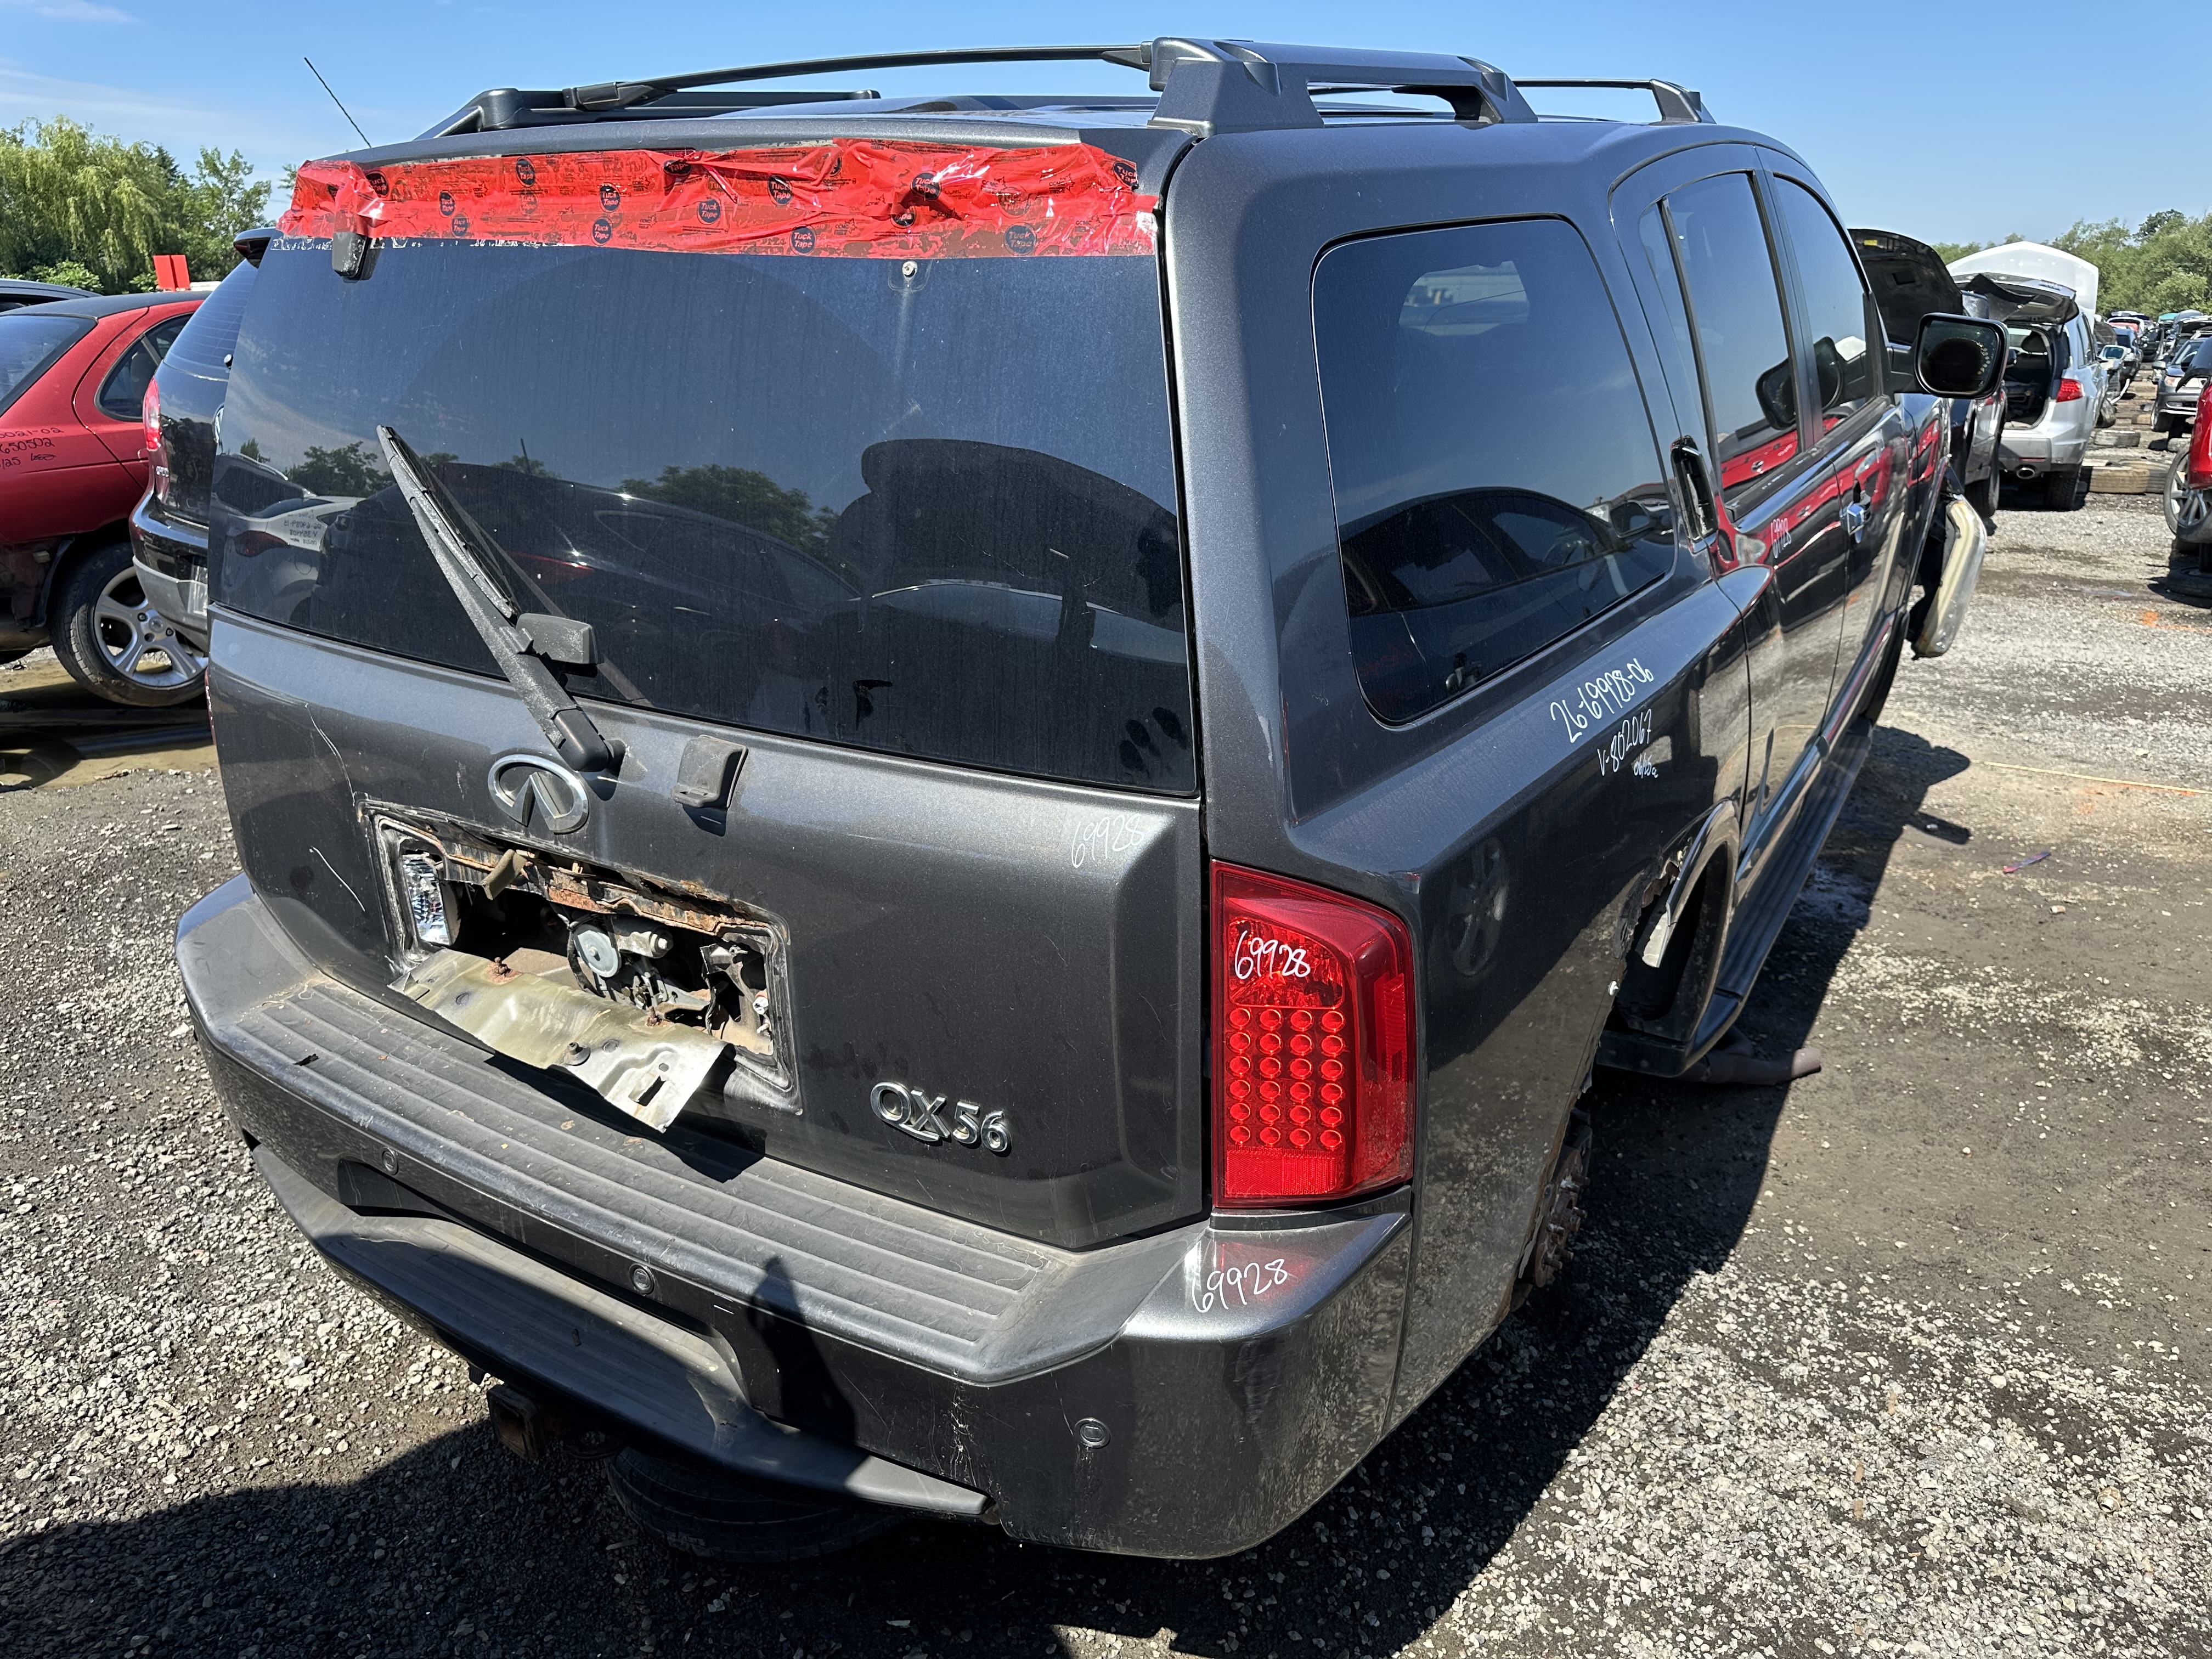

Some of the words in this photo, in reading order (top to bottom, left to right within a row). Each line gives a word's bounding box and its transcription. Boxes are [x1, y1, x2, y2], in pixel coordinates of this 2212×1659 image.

[518, 165, 532, 173] Tuck
[1120, 173, 1137, 184] Tap
[442, 205, 454, 213] Tape
[701, 202, 718, 211] Tuck
[701, 210, 718, 219] Tape
[594, 223, 609, 232] Tuck
[594, 231, 610, 240] Tape
[794, 232, 812, 241] Tuck
[1008, 230, 1031, 240] Tuck
[794, 240, 814, 250] Tape
[1071, 813, 1144, 868] 69928
[1234, 930, 1311, 980] 69928
[1192, 1258, 1288, 1313] 69928
